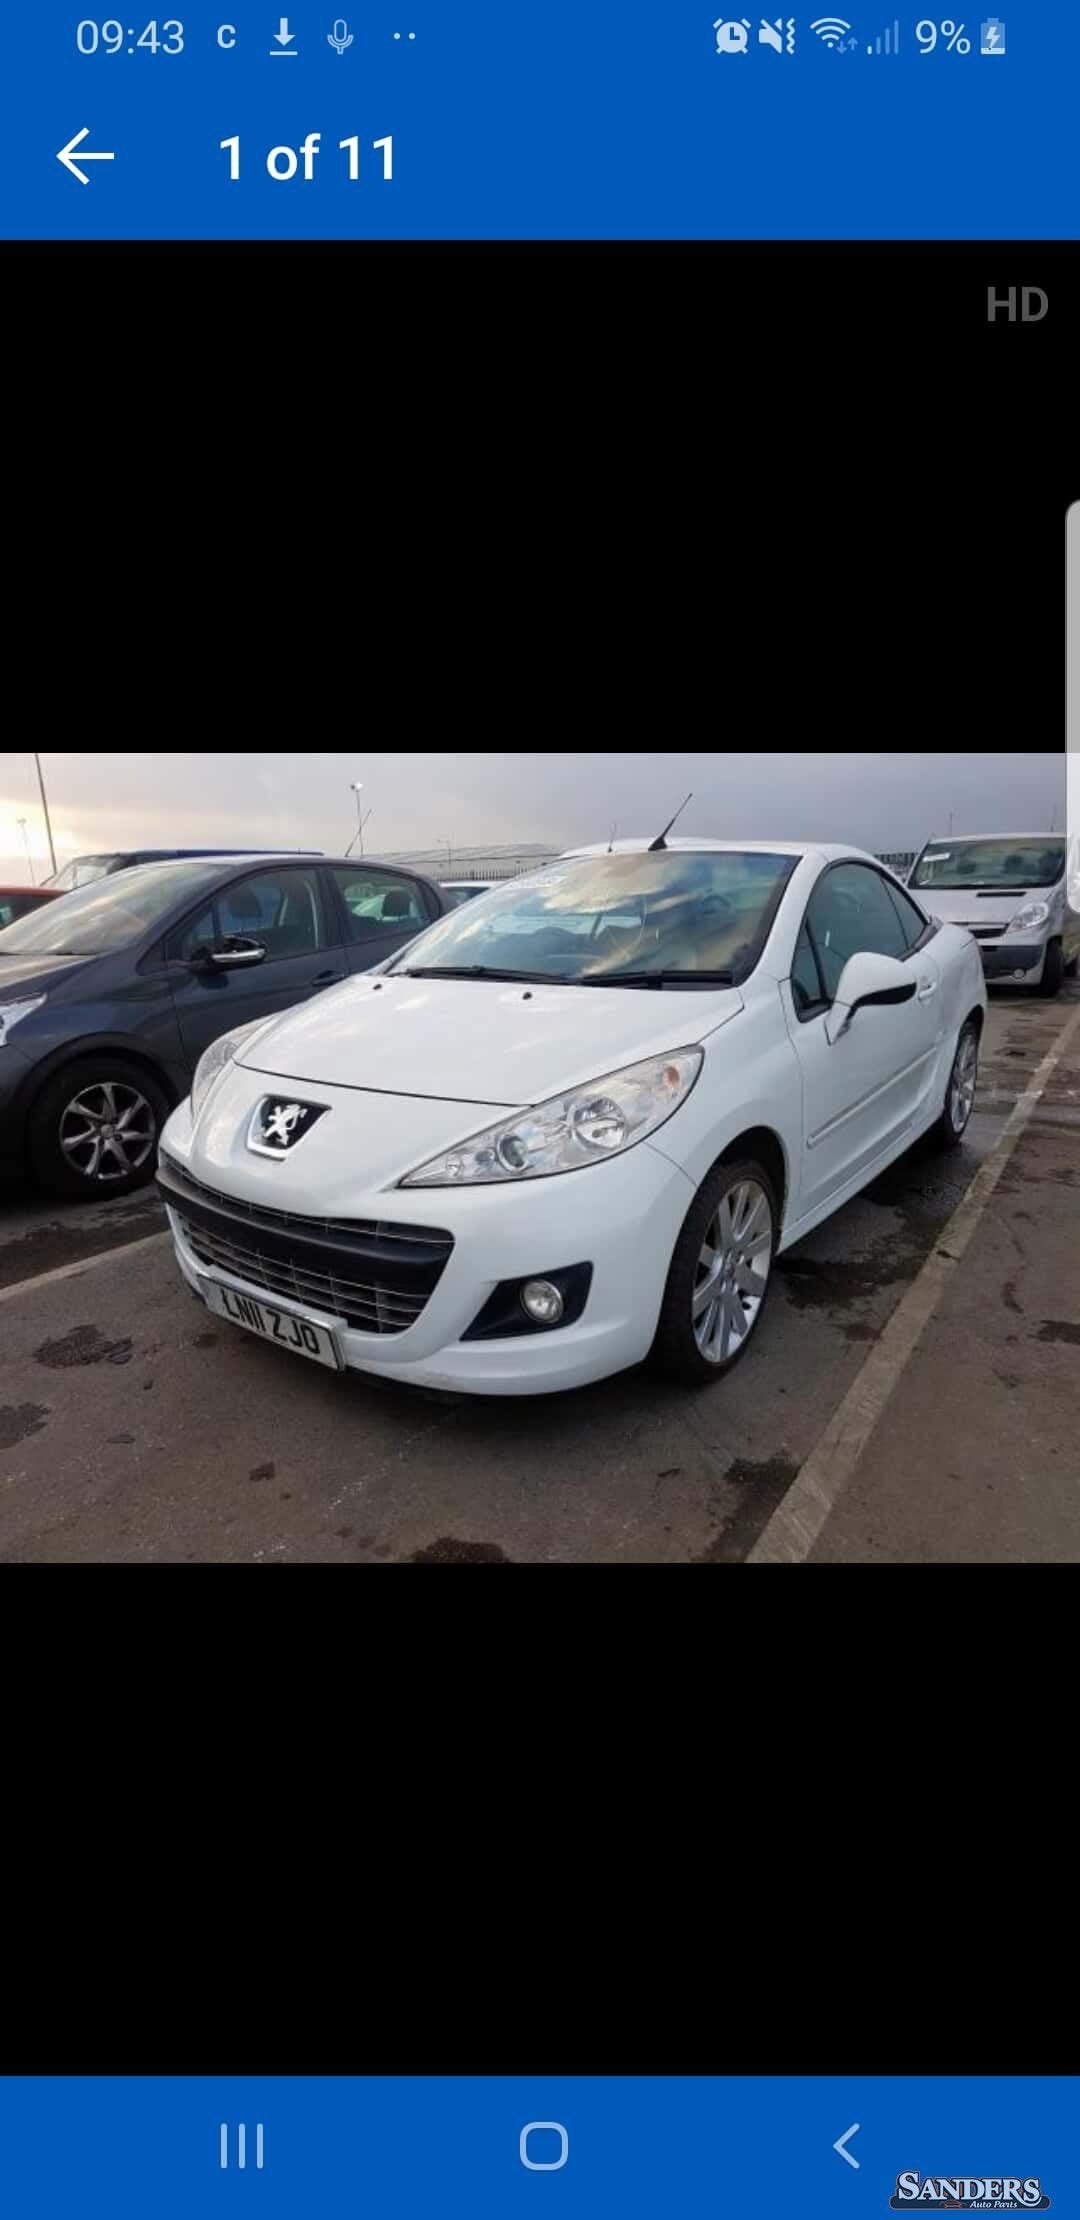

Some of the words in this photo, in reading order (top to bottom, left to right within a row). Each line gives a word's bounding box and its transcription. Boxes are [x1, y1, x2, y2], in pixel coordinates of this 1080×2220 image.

[76, 19, 185, 55] 09:43
[915, 19, 971, 55] 9%
[220, 135, 240, 180] 1
[266, 132, 321, 181] of
[339, 135, 393, 180] 11
[986, 285, 1049, 322] HD
[220, 1288, 267, 1332] LN11
